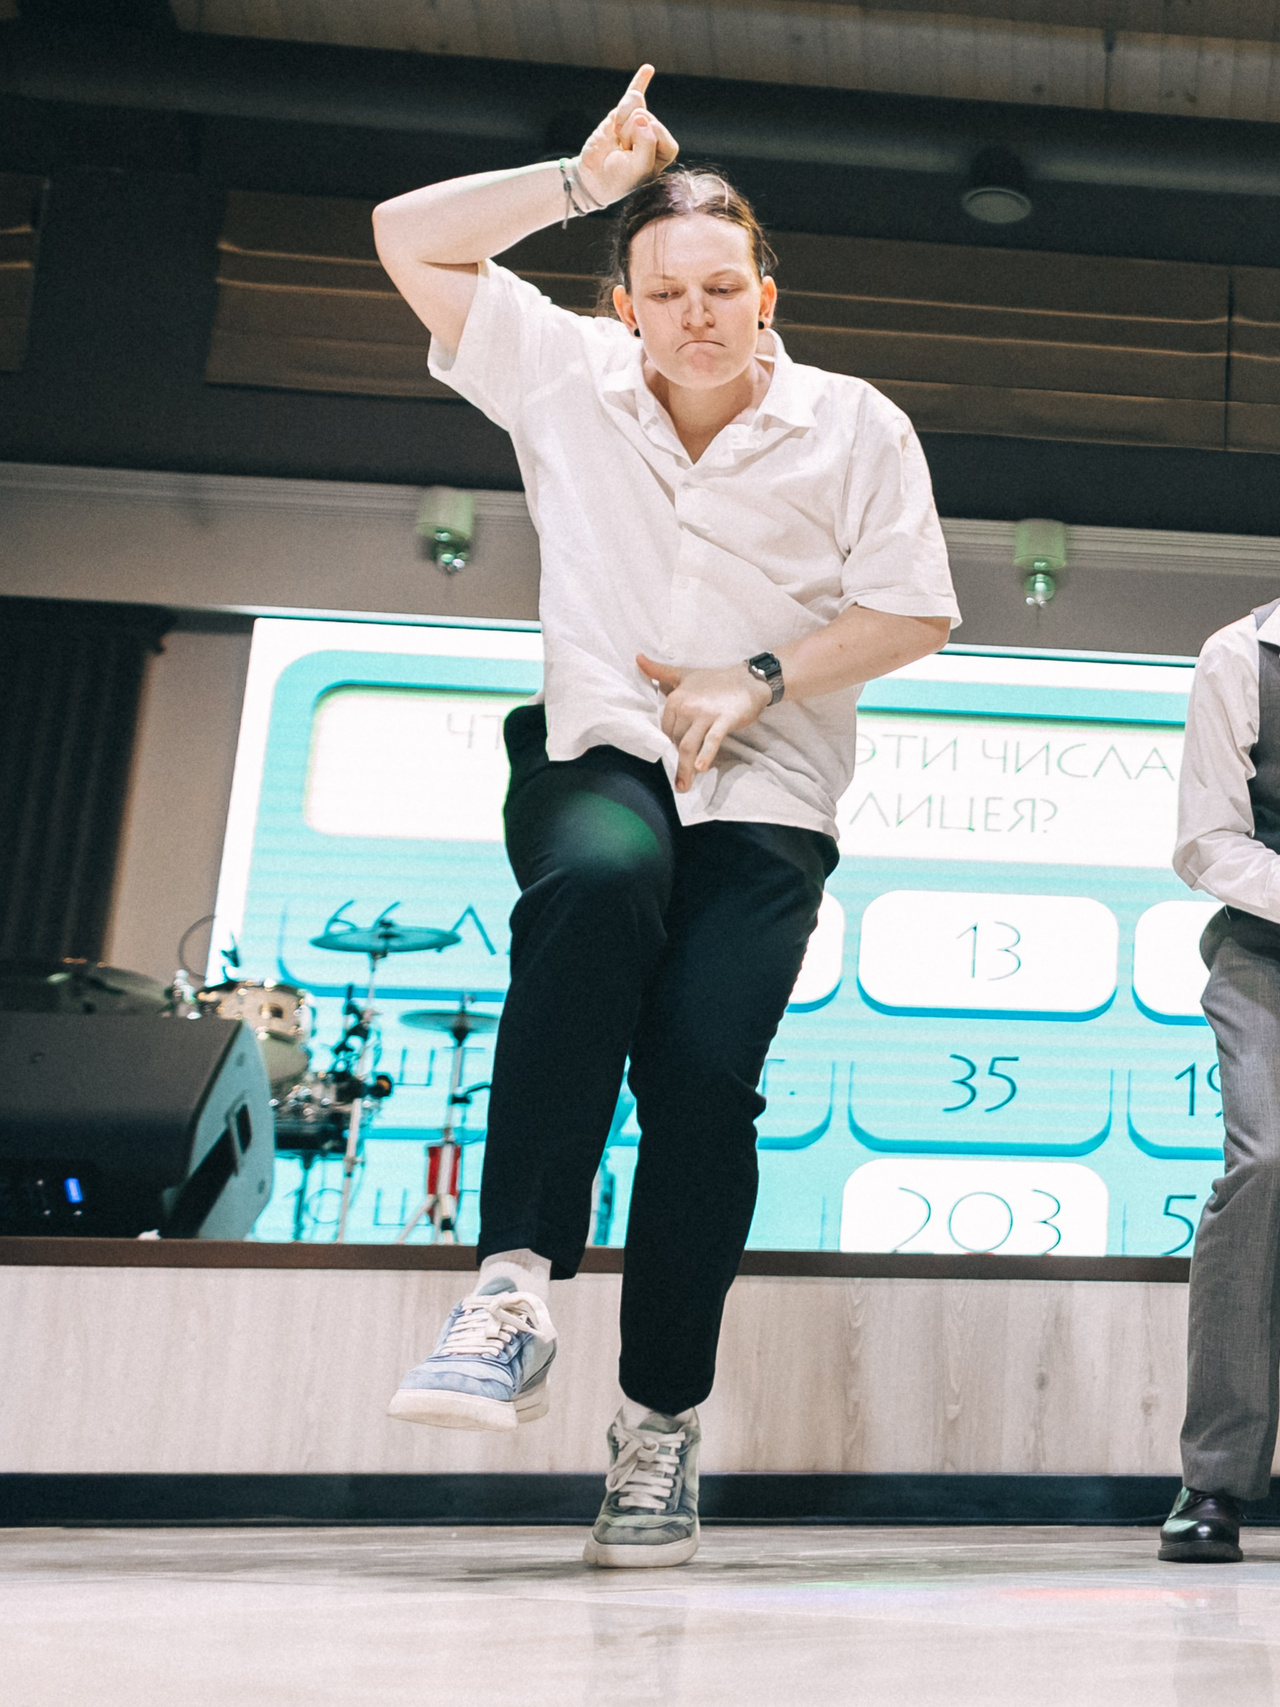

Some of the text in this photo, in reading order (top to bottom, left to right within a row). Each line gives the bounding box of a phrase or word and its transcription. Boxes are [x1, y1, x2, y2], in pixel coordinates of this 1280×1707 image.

[856, 732, 958, 773] ЭТИ
[981, 738, 1176, 783] ЧИСЛА
[848, 790, 1060, 835] ЛИЦЕЯ?
[955, 920, 1022, 982] 13
[941, 1052, 1021, 1114] 35
[891, 1186, 1062, 1255] 203
